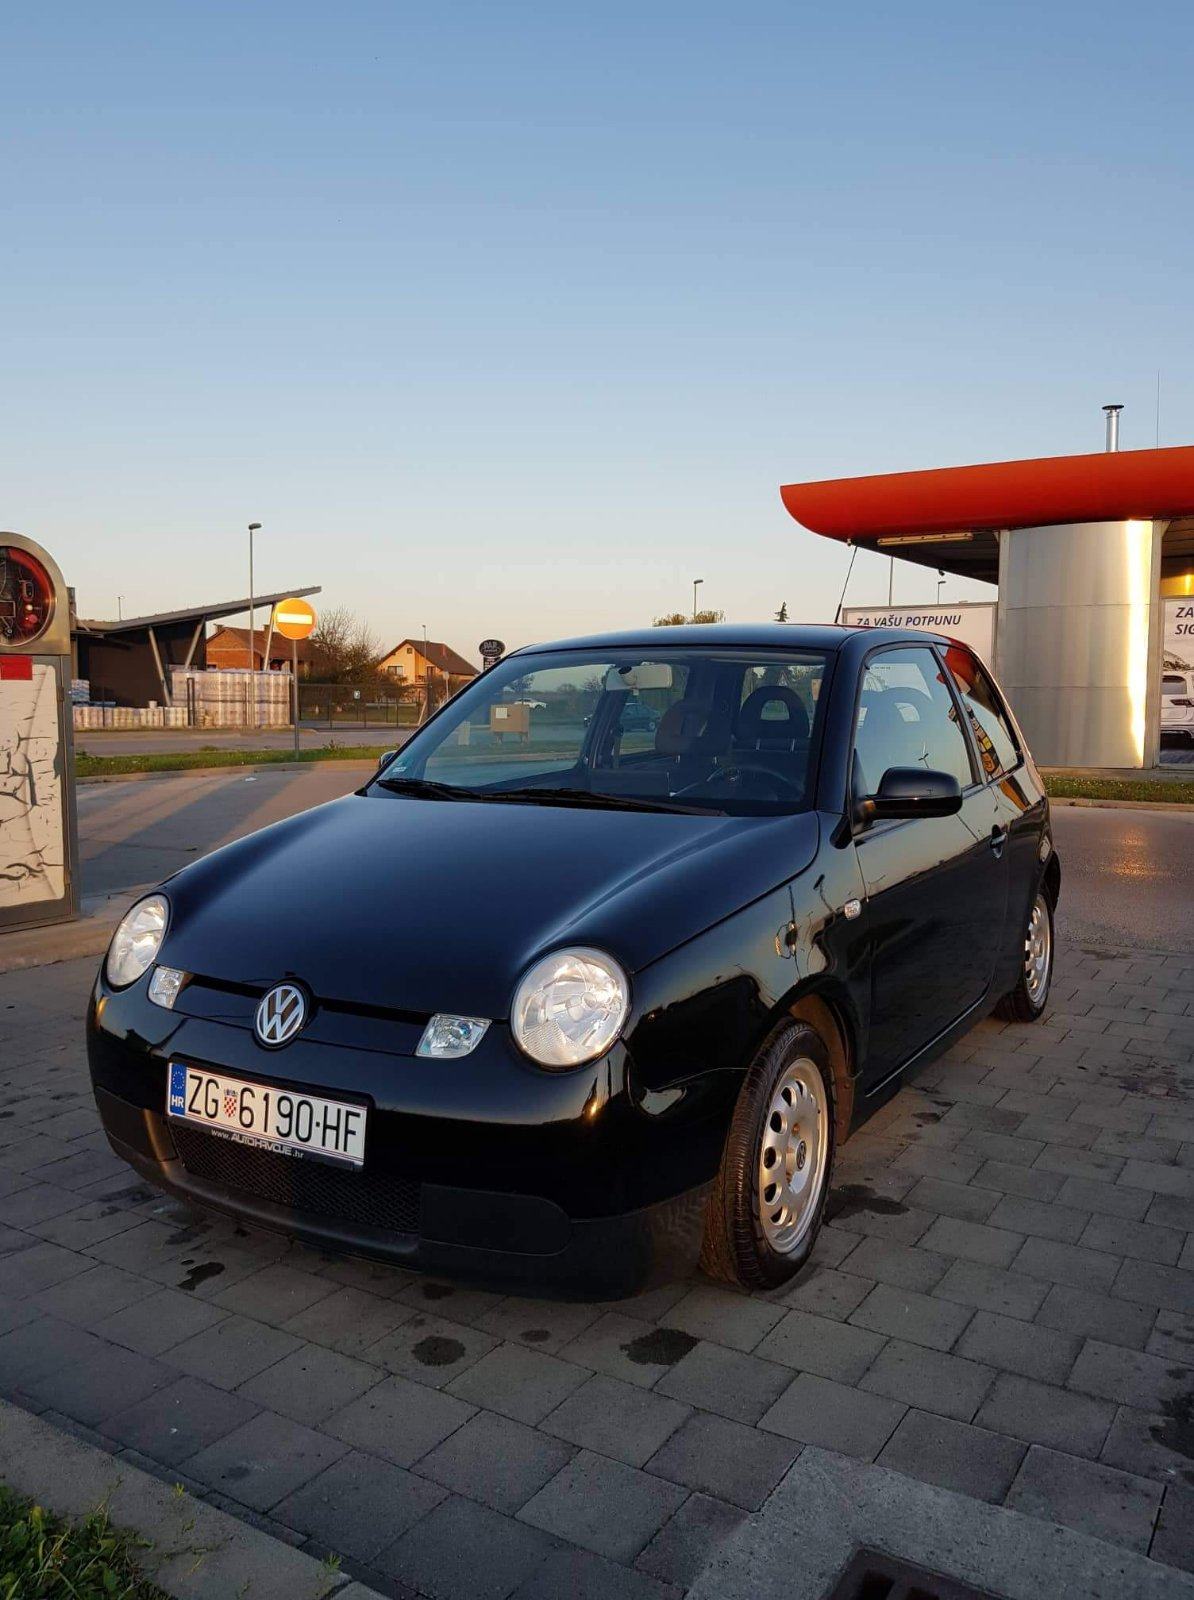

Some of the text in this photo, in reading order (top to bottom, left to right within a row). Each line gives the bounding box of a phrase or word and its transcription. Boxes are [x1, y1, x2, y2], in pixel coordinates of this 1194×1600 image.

[1175, 606, 1194, 618] ZA
[874, 614, 903, 627] VAŠU
[905, 614, 962, 627] POTPUNU
[171, 1094, 184, 1109] HR
[188, 1074, 220, 1119] ZG
